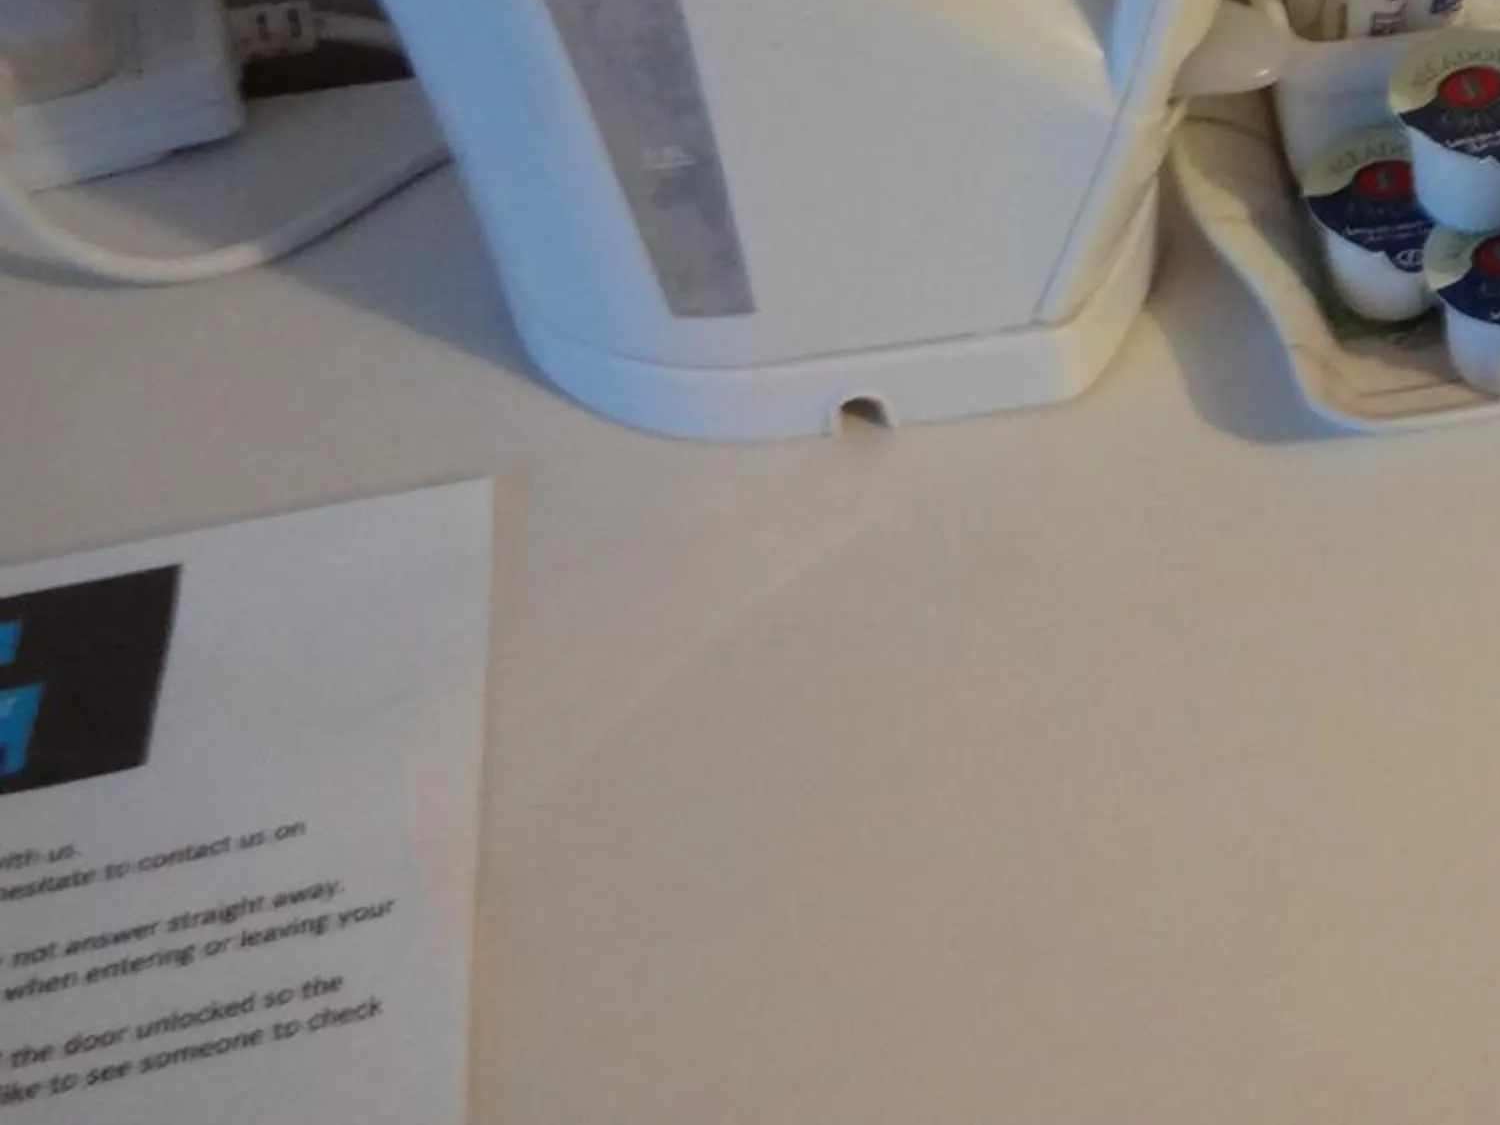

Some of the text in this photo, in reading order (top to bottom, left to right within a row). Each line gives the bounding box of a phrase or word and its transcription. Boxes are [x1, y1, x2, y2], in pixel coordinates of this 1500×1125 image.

[104, 861, 131, 882] to
[137, 836, 231, 873] contact
[239, 829, 266, 850] us
[273, 820, 308, 842] on
[4, 896, 397, 1002] when entering or leaving your
[13, 941, 57, 967] not
[65, 920, 161, 956] answer
[166, 895, 264, 933] straight
[10, 973, 344, 1069] the door unlocked so the
[49, 1072, 80, 1095] to
[85, 1059, 133, 1086] see
[138, 1028, 263, 1075] someone
[273, 1018, 300, 1041] to
[306, 994, 384, 1033] check
